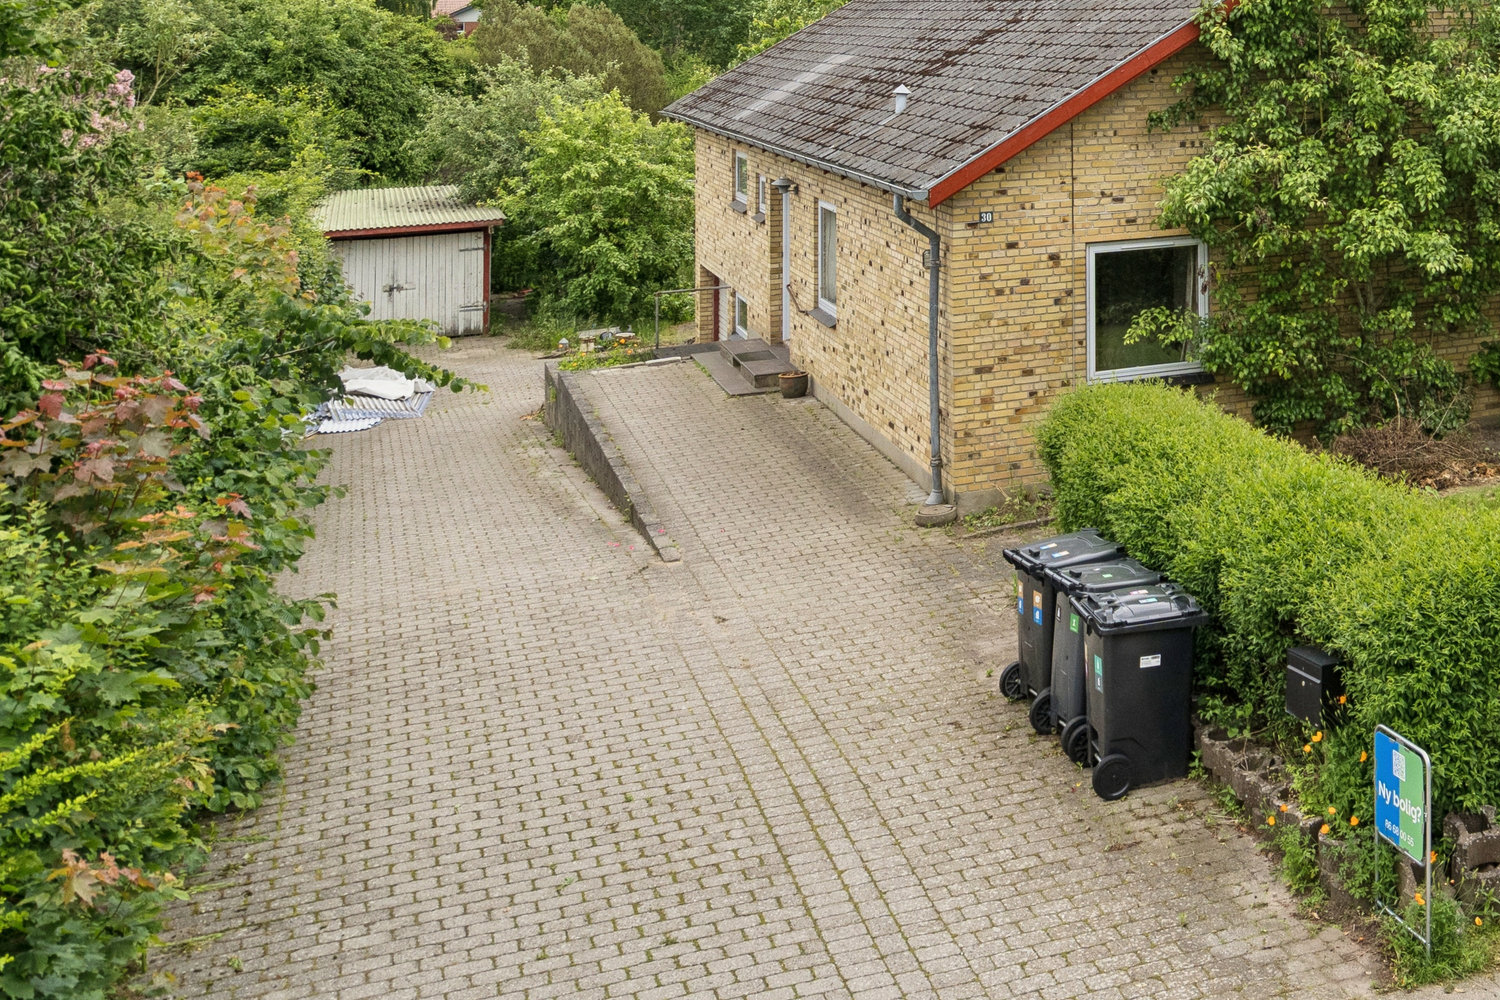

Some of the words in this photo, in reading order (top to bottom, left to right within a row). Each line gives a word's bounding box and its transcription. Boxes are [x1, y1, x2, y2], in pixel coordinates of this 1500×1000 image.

[981, 212, 992, 222] 30
[1378, 780, 1391, 805] Ny
[1393, 790, 1421, 823] bolig?
[1400, 830, 1407, 841] 00
[1407, 834, 1414, 847] 55
